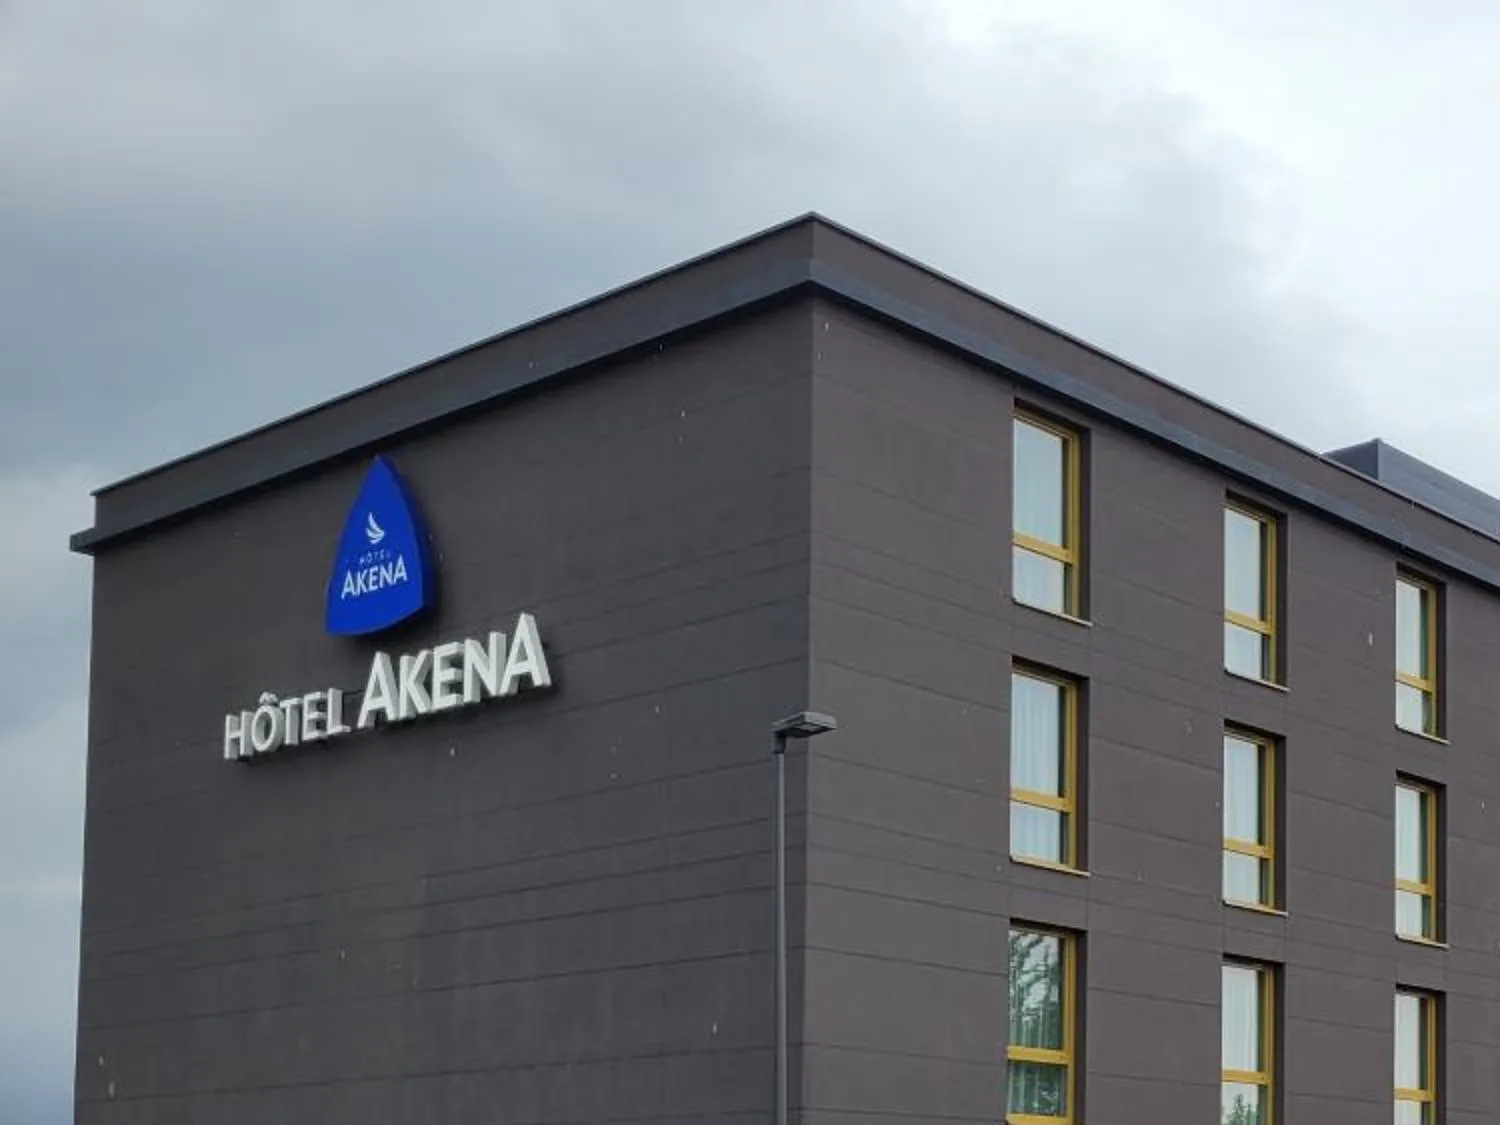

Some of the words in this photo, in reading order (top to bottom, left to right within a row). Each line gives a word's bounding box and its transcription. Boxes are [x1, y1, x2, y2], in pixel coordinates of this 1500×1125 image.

[341, 553, 408, 600] AKENA
[224, 687, 350, 759] HÔTEL
[356, 612, 551, 729] AKENA
